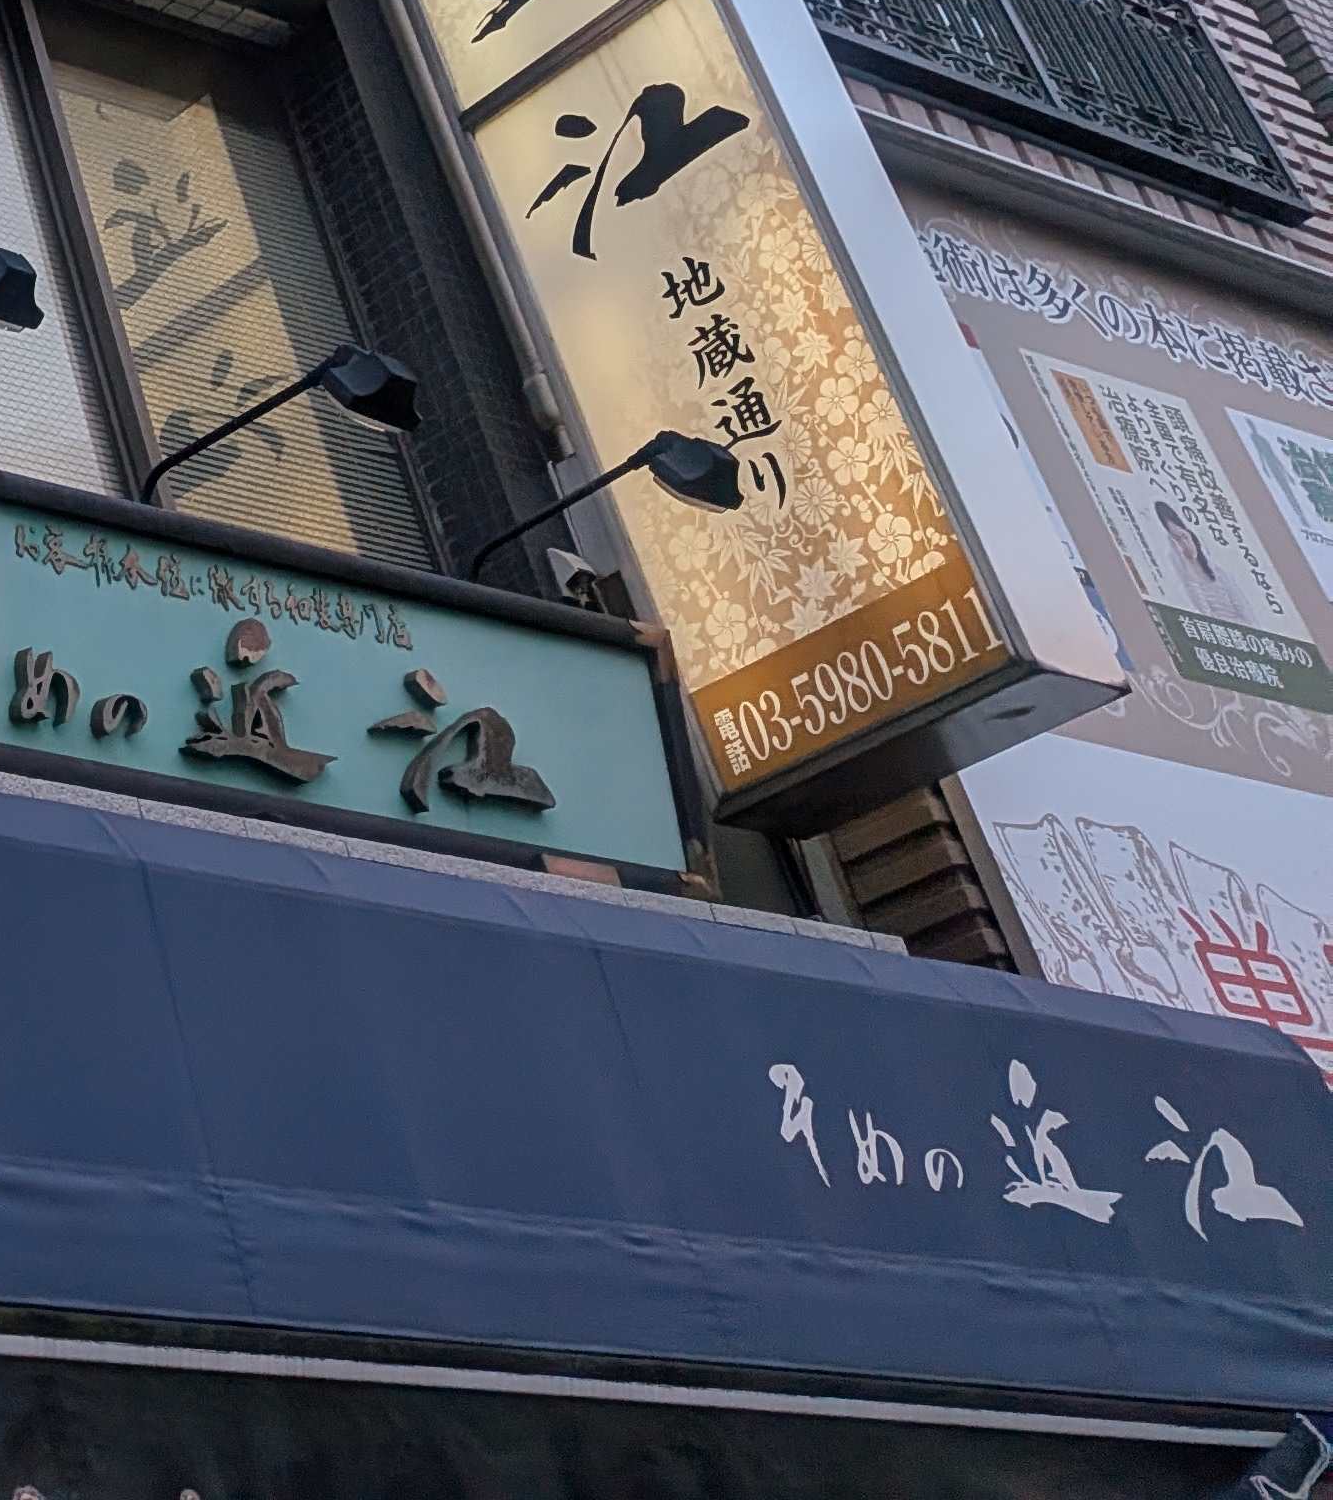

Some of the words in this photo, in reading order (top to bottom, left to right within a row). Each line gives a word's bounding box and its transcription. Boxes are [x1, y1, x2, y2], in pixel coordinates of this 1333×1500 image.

[660, 256, 787, 510] 地蔵通り
[1126, 393, 1200, 525] よりすぐりの
[1143, 398, 1229, 547] 全国で有名な
[1162, 403, 1284, 615] 頭痛改善するなら
[714, 708, 751, 776] 電話
[737, 586, 1004, 763] 03-5980-5811
[768, 1059, 1304, 1242] そめの近江
